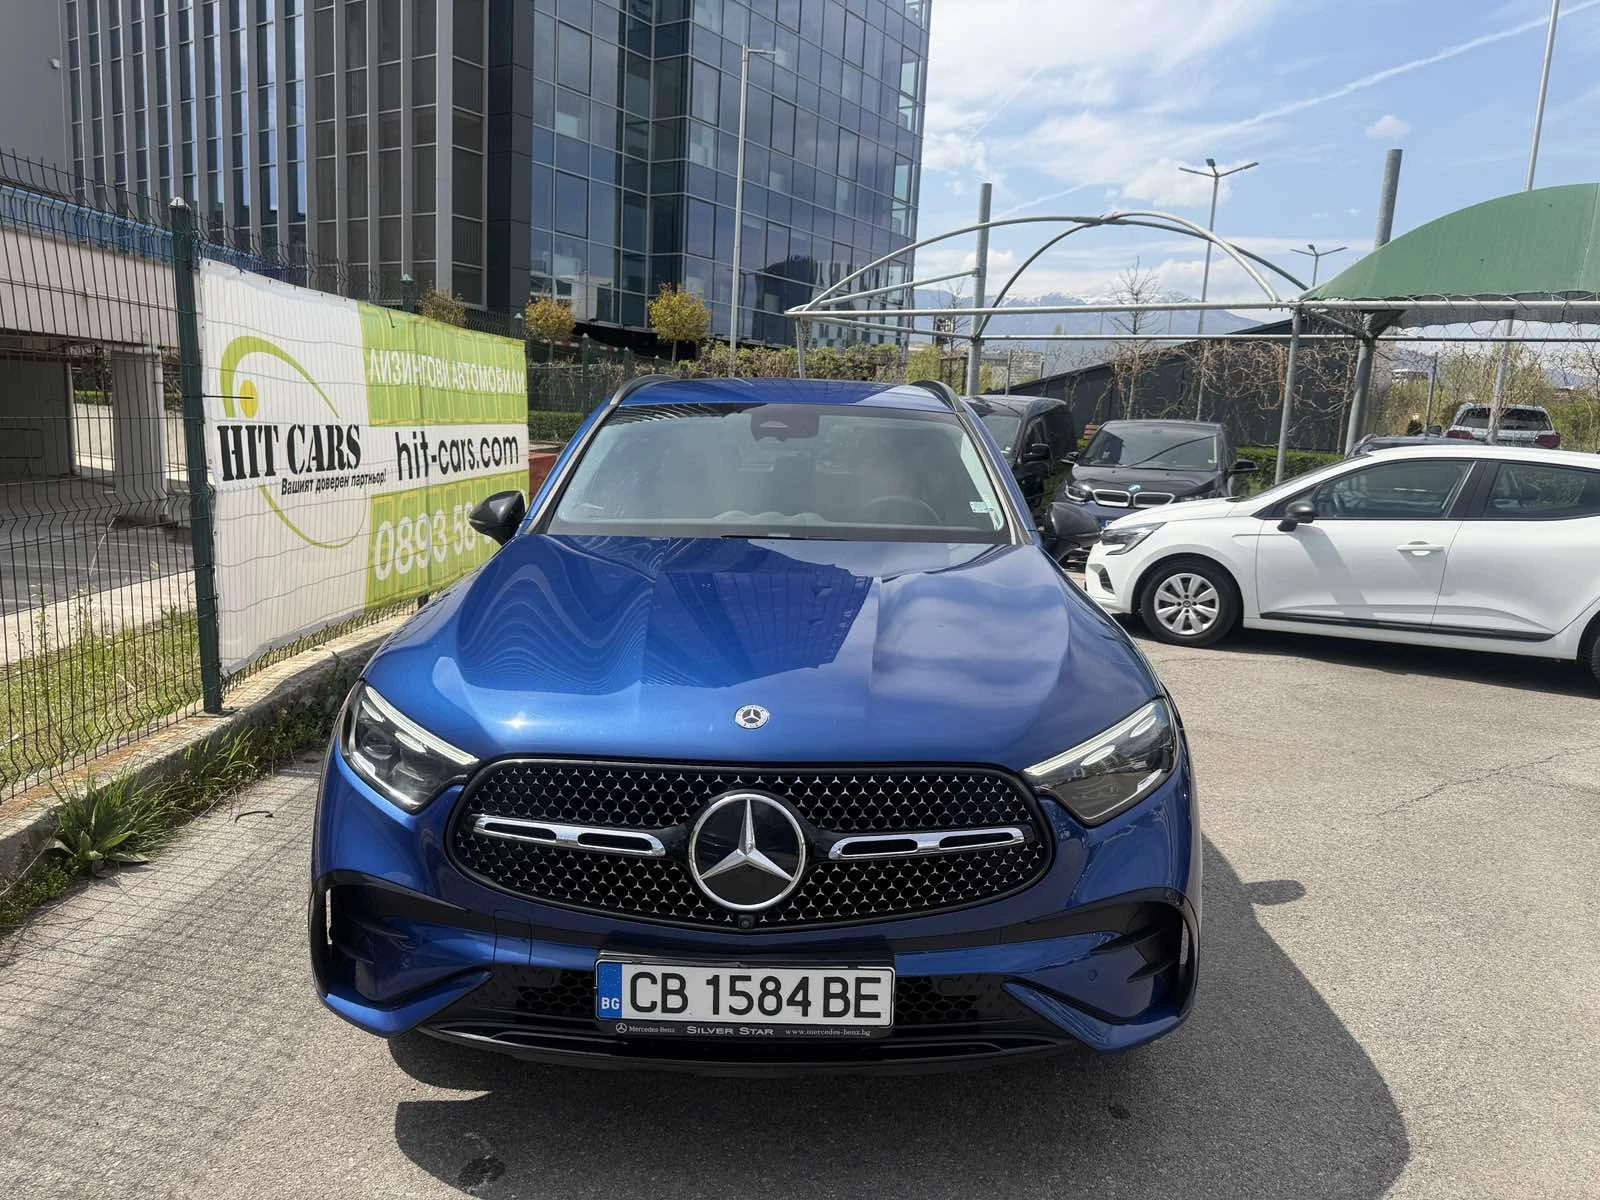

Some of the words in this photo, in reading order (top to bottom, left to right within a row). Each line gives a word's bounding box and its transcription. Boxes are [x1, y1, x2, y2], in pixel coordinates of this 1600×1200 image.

[369, 349, 449, 388] ЛИЗИНГОВИ
[452, 361, 525, 394] АВТОМОБИЛИ
[217, 425, 279, 482] HIT
[287, 424, 361, 475] CARS
[395, 431, 518, 481] hit-cars.com
[281, 478, 314, 496] Вашият
[315, 475, 349, 493] доверен
[350, 468, 387, 488] партньор!
[375, 508, 447, 581] 0893
[601, 997, 620, 1009] BG
[630, 971, 688, 1013] CB
[706, 974, 811, 1017] 1584
[823, 976, 881, 1018] BE
[628, 1025, 675, 1033] Mercedes-Benz
[687, 1025, 734, 1035] SILVER
[739, 1026, 774, 1036] STAR
[785, 1028, 871, 1036] www.mercedes-benz.bg
